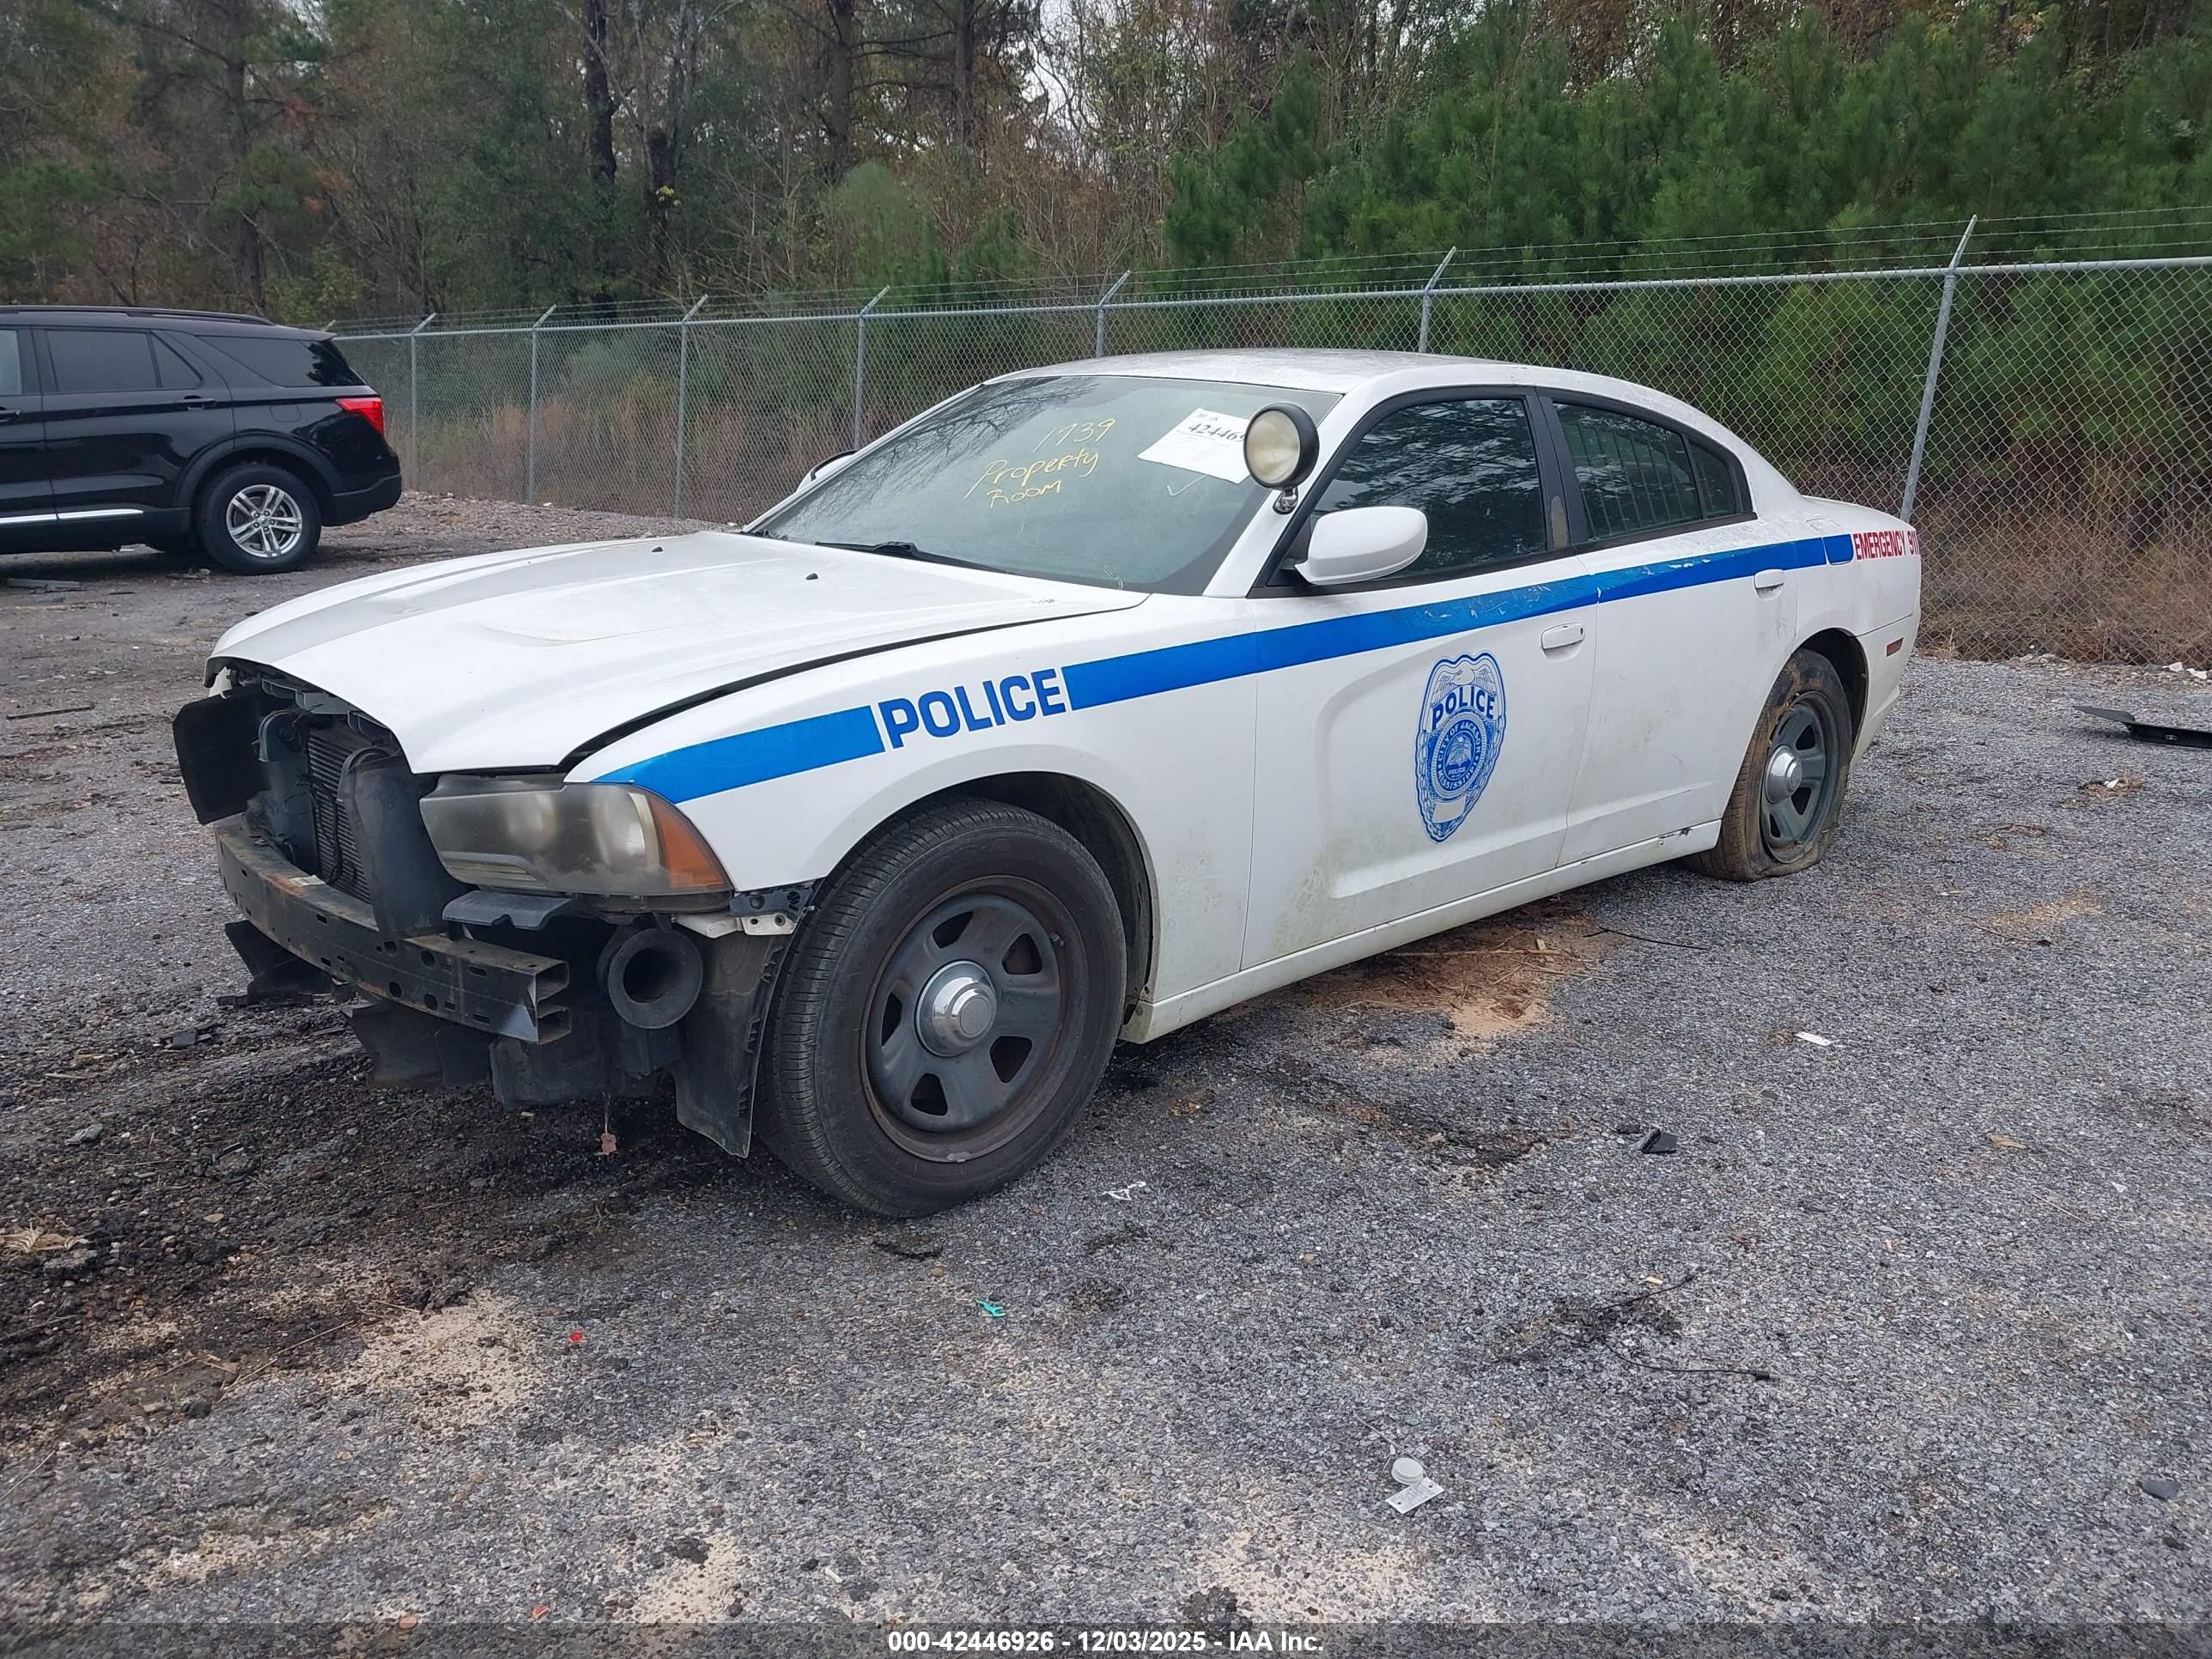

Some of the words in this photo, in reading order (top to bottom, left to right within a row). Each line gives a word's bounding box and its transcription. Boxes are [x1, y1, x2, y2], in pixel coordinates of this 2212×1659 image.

[1032, 418, 1116, 453] 1739
[1853, 530, 1906, 560] EMERGENCY
[878, 668, 1066, 749] POLICE
[1432, 685, 1497, 730] POLICE
[1437, 734, 1449, 762] CITY
[1449, 724, 1460, 736] OF
[1460, 721, 1481, 753] JACKSON
[1437, 763, 1477, 789] MISSISSIPPI
